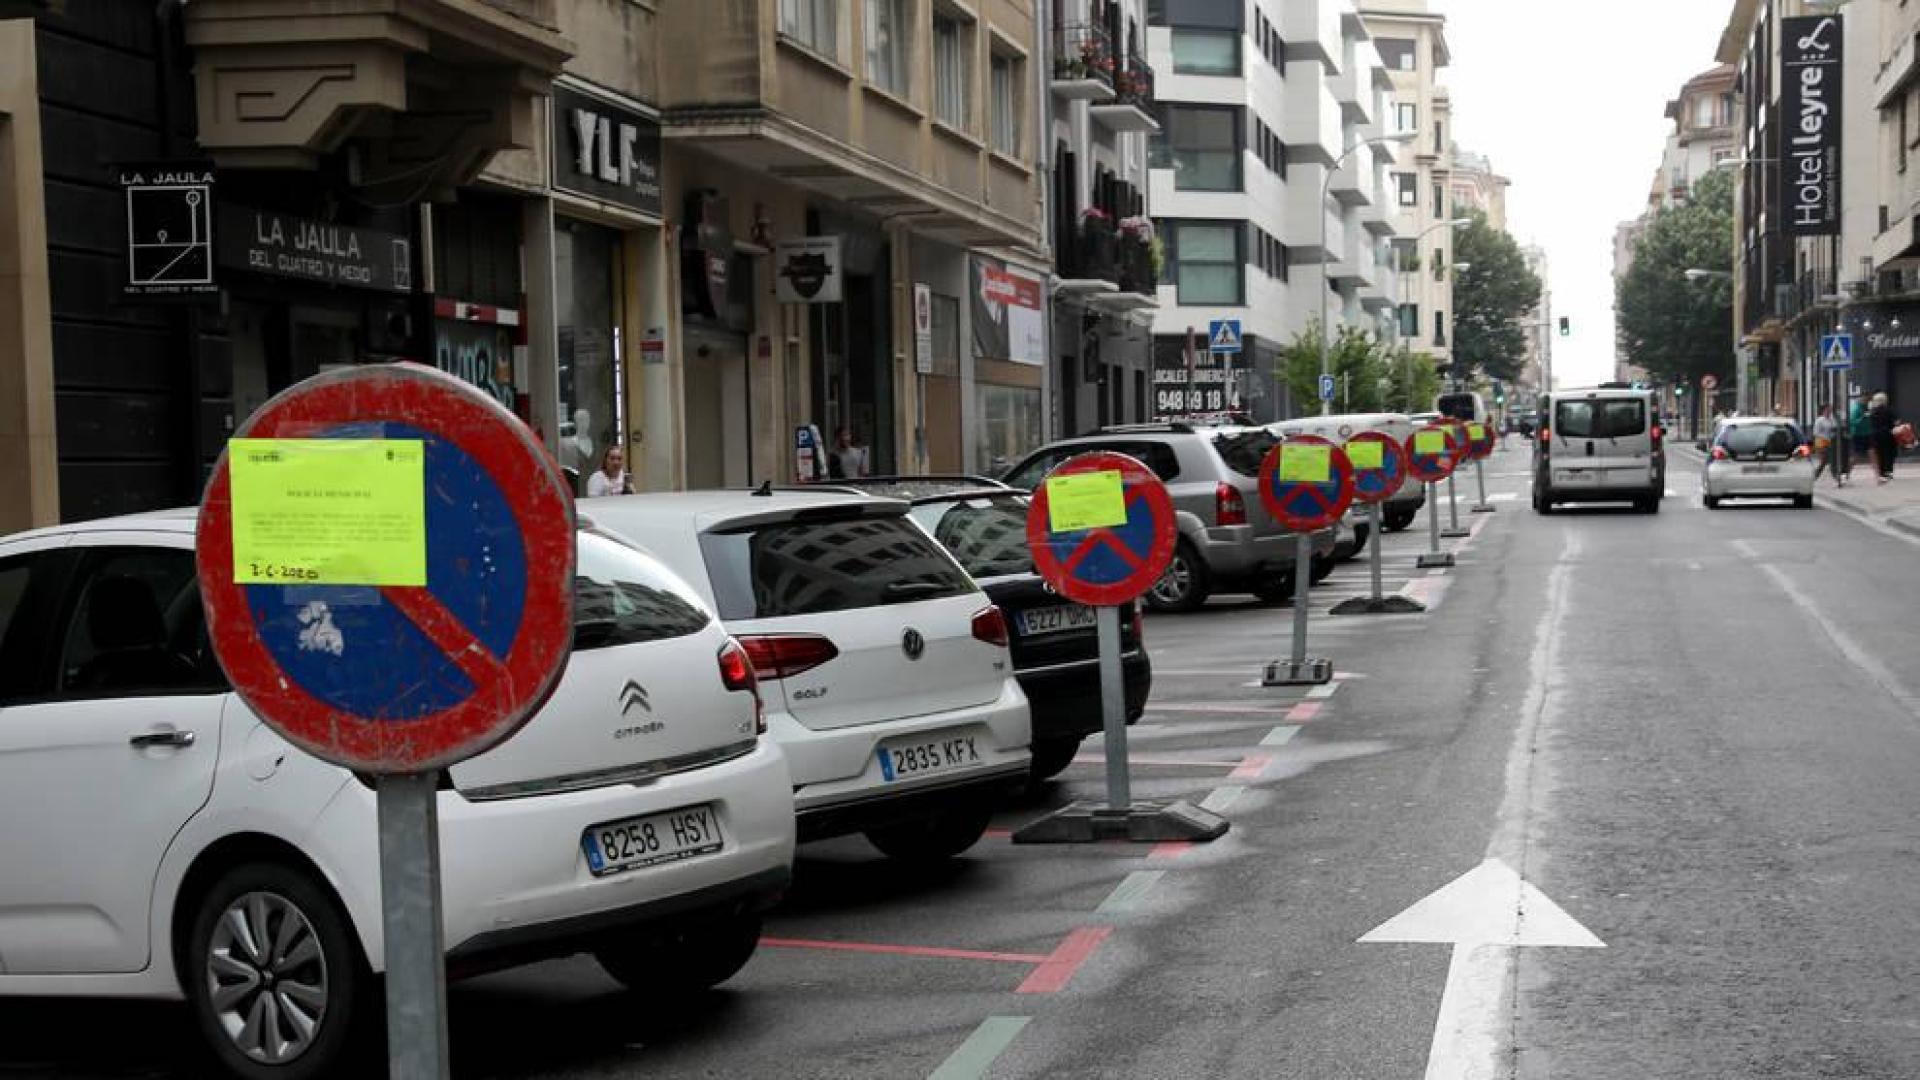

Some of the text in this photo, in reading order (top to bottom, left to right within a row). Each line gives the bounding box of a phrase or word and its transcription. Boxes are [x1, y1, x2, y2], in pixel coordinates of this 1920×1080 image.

[574, 109, 637, 187] YLF
[1792, 66, 1828, 226] Hotel leyre
[121, 172, 215, 185] LA JAULA
[257, 214, 361, 260] LA JAULA
[250, 250, 272, 268] DEL
[278, 254, 323, 276] CUATRO
[1158, 389, 1184, 410] 948
[1207, 389, 1221, 410] 18
[793, 688, 828, 700] GOLF
[893, 736, 979, 774] 2835 KFX
[602, 823, 660, 860] 8258
[670, 809, 711, 847] HSY
